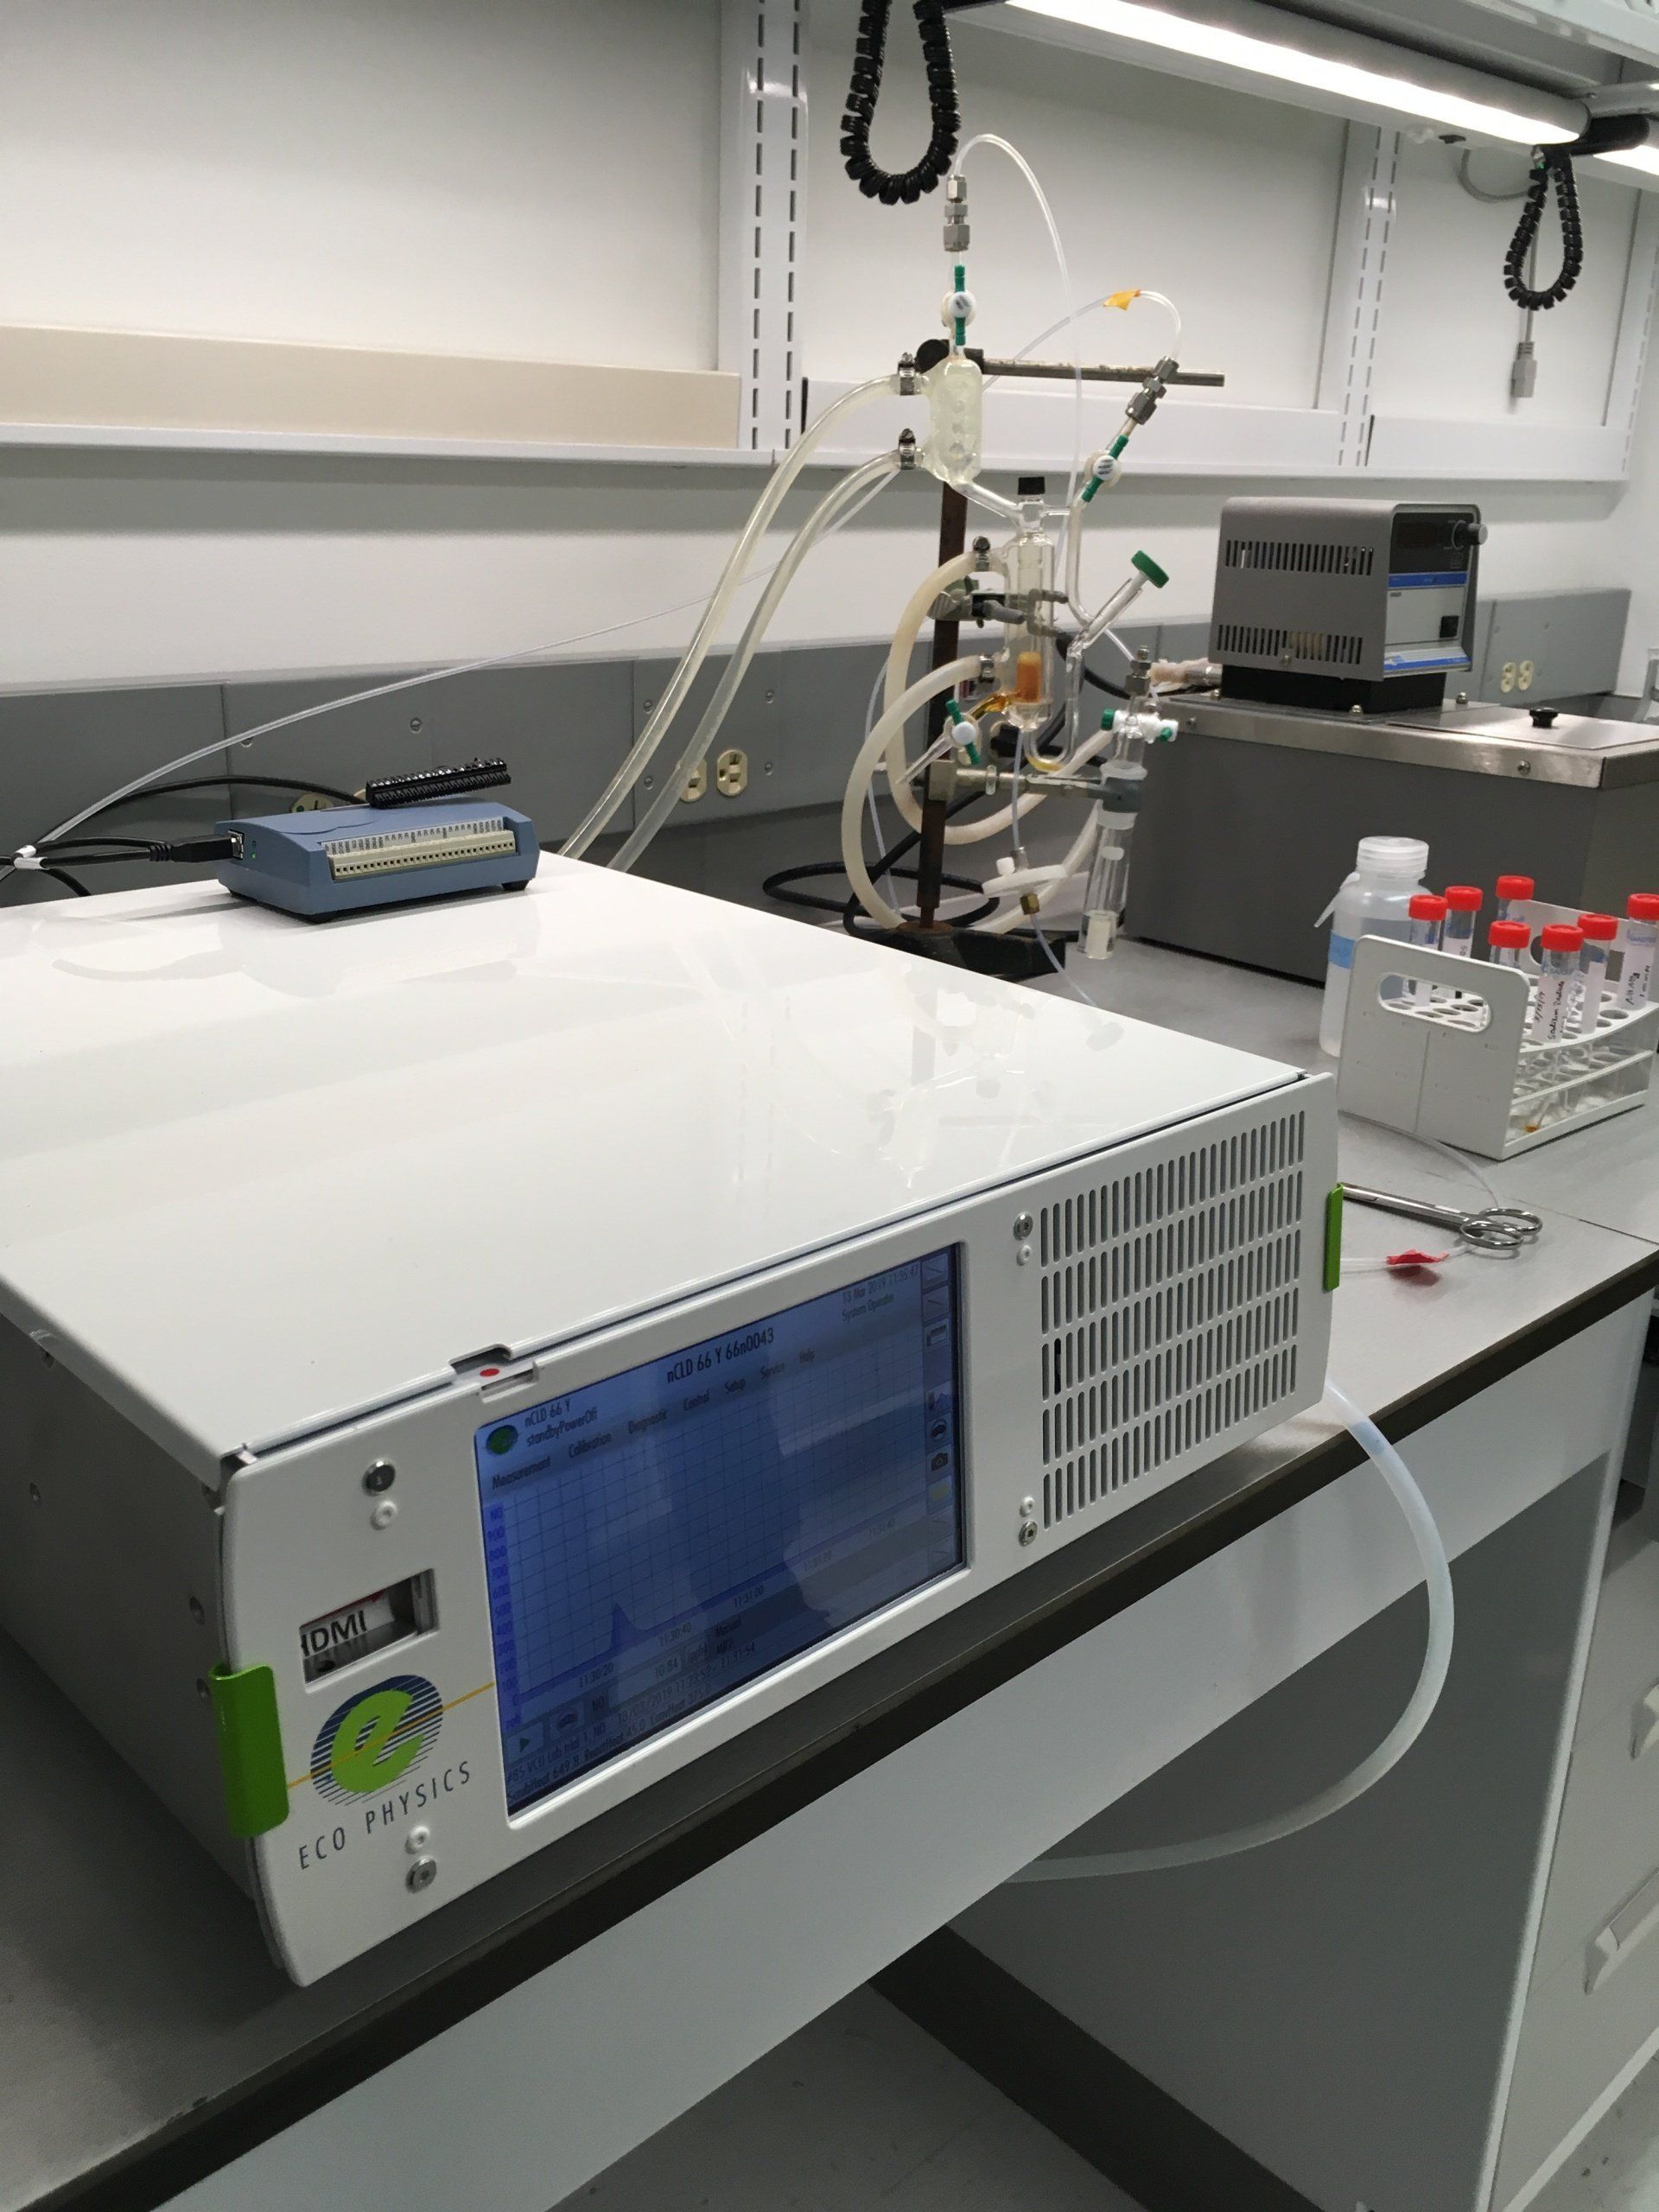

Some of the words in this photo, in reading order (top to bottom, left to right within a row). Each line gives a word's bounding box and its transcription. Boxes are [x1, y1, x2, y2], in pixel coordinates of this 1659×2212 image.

[842, 1302, 865, 1324] System
[697, 1352, 710, 1371] 66
[715, 1348, 721, 1363] Y
[492, 1457, 549, 1490] Measurement
[568, 1430, 611, 1459] Calibration
[628, 1408, 666, 1437] Diagnostic
[683, 1390, 709, 1411] Control
[726, 1376, 745, 1397] Setup
[760, 1359, 784, 1380] Service
[799, 1348, 815, 1365] Help
[550, 1403, 561, 1418] 66
[563, 1400, 569, 1412] Y
[299, 1827, 346, 1871] ECO
[365, 1761, 471, 1834] PHYSICS
